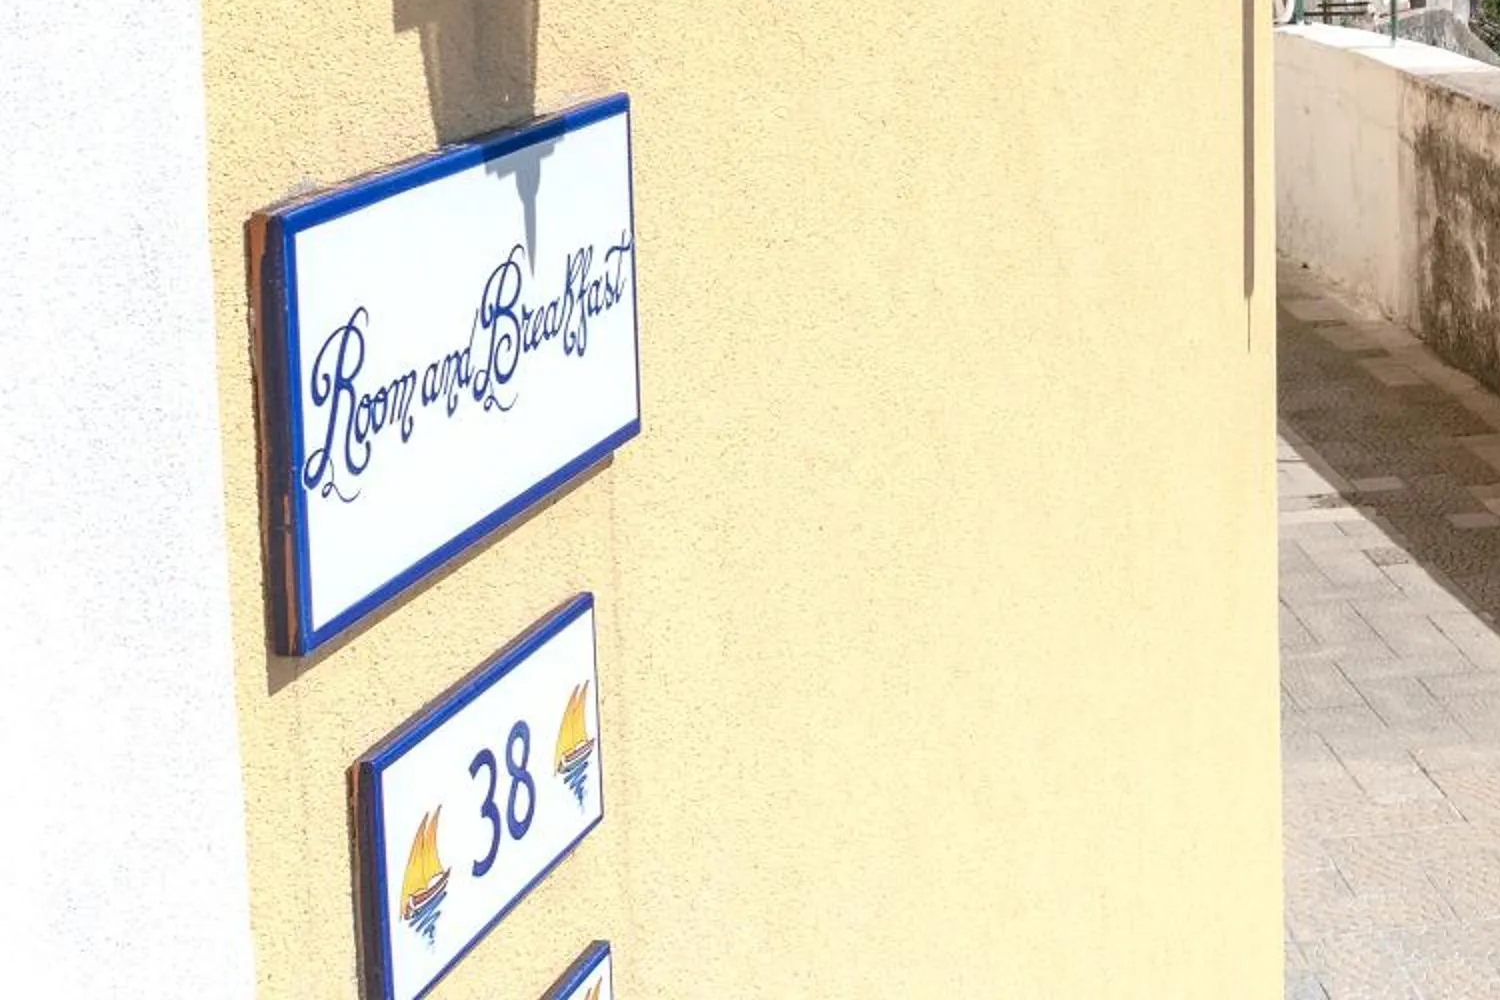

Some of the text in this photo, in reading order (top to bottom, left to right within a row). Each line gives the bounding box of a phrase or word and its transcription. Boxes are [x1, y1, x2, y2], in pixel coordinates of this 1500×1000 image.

[304, 228, 634, 502] Room and Breakfast
[468, 720, 537, 878] 38
